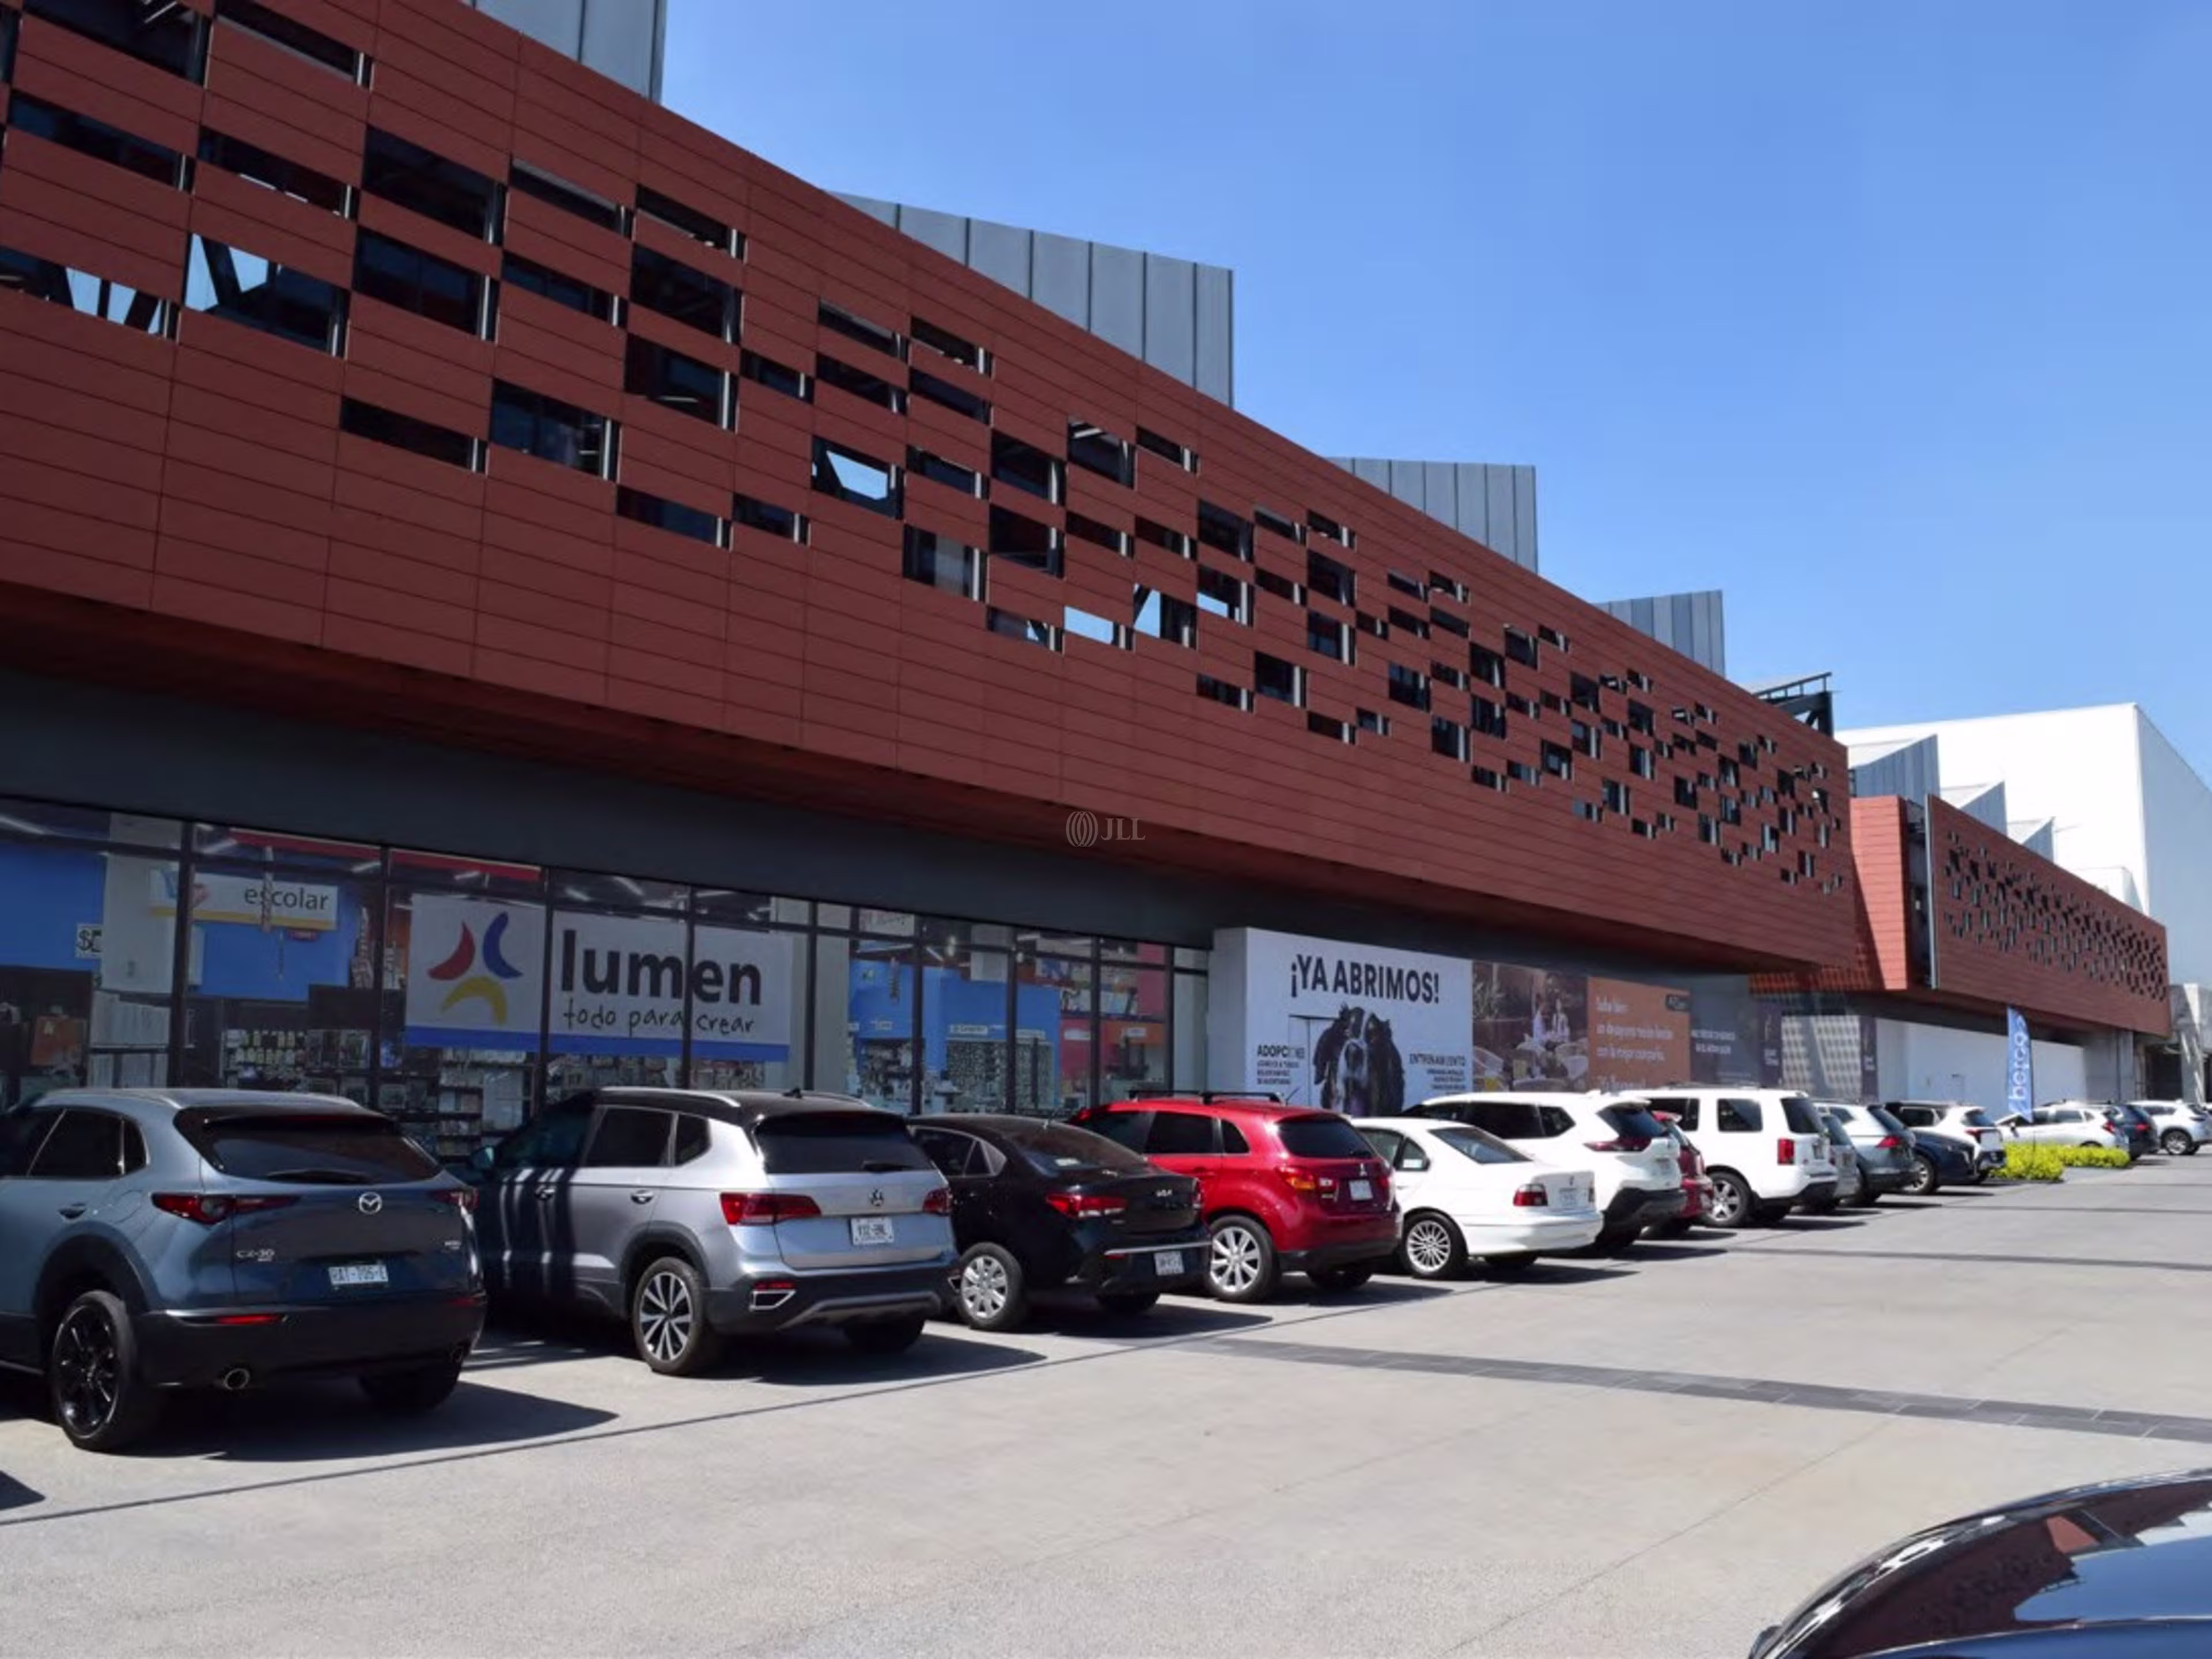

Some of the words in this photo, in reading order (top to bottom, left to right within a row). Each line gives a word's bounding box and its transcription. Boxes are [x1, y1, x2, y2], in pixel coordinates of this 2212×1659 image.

[244, 887, 329, 910] escolar
[562, 929, 762, 1006] lumen
[1291, 954, 1328, 998] ¡YA
[1332, 960, 1440, 1003] ABRIMOS!
[563, 998, 616, 1030] todo
[629, 1010, 684, 1037] para
[696, 1014, 755, 1035] crear
